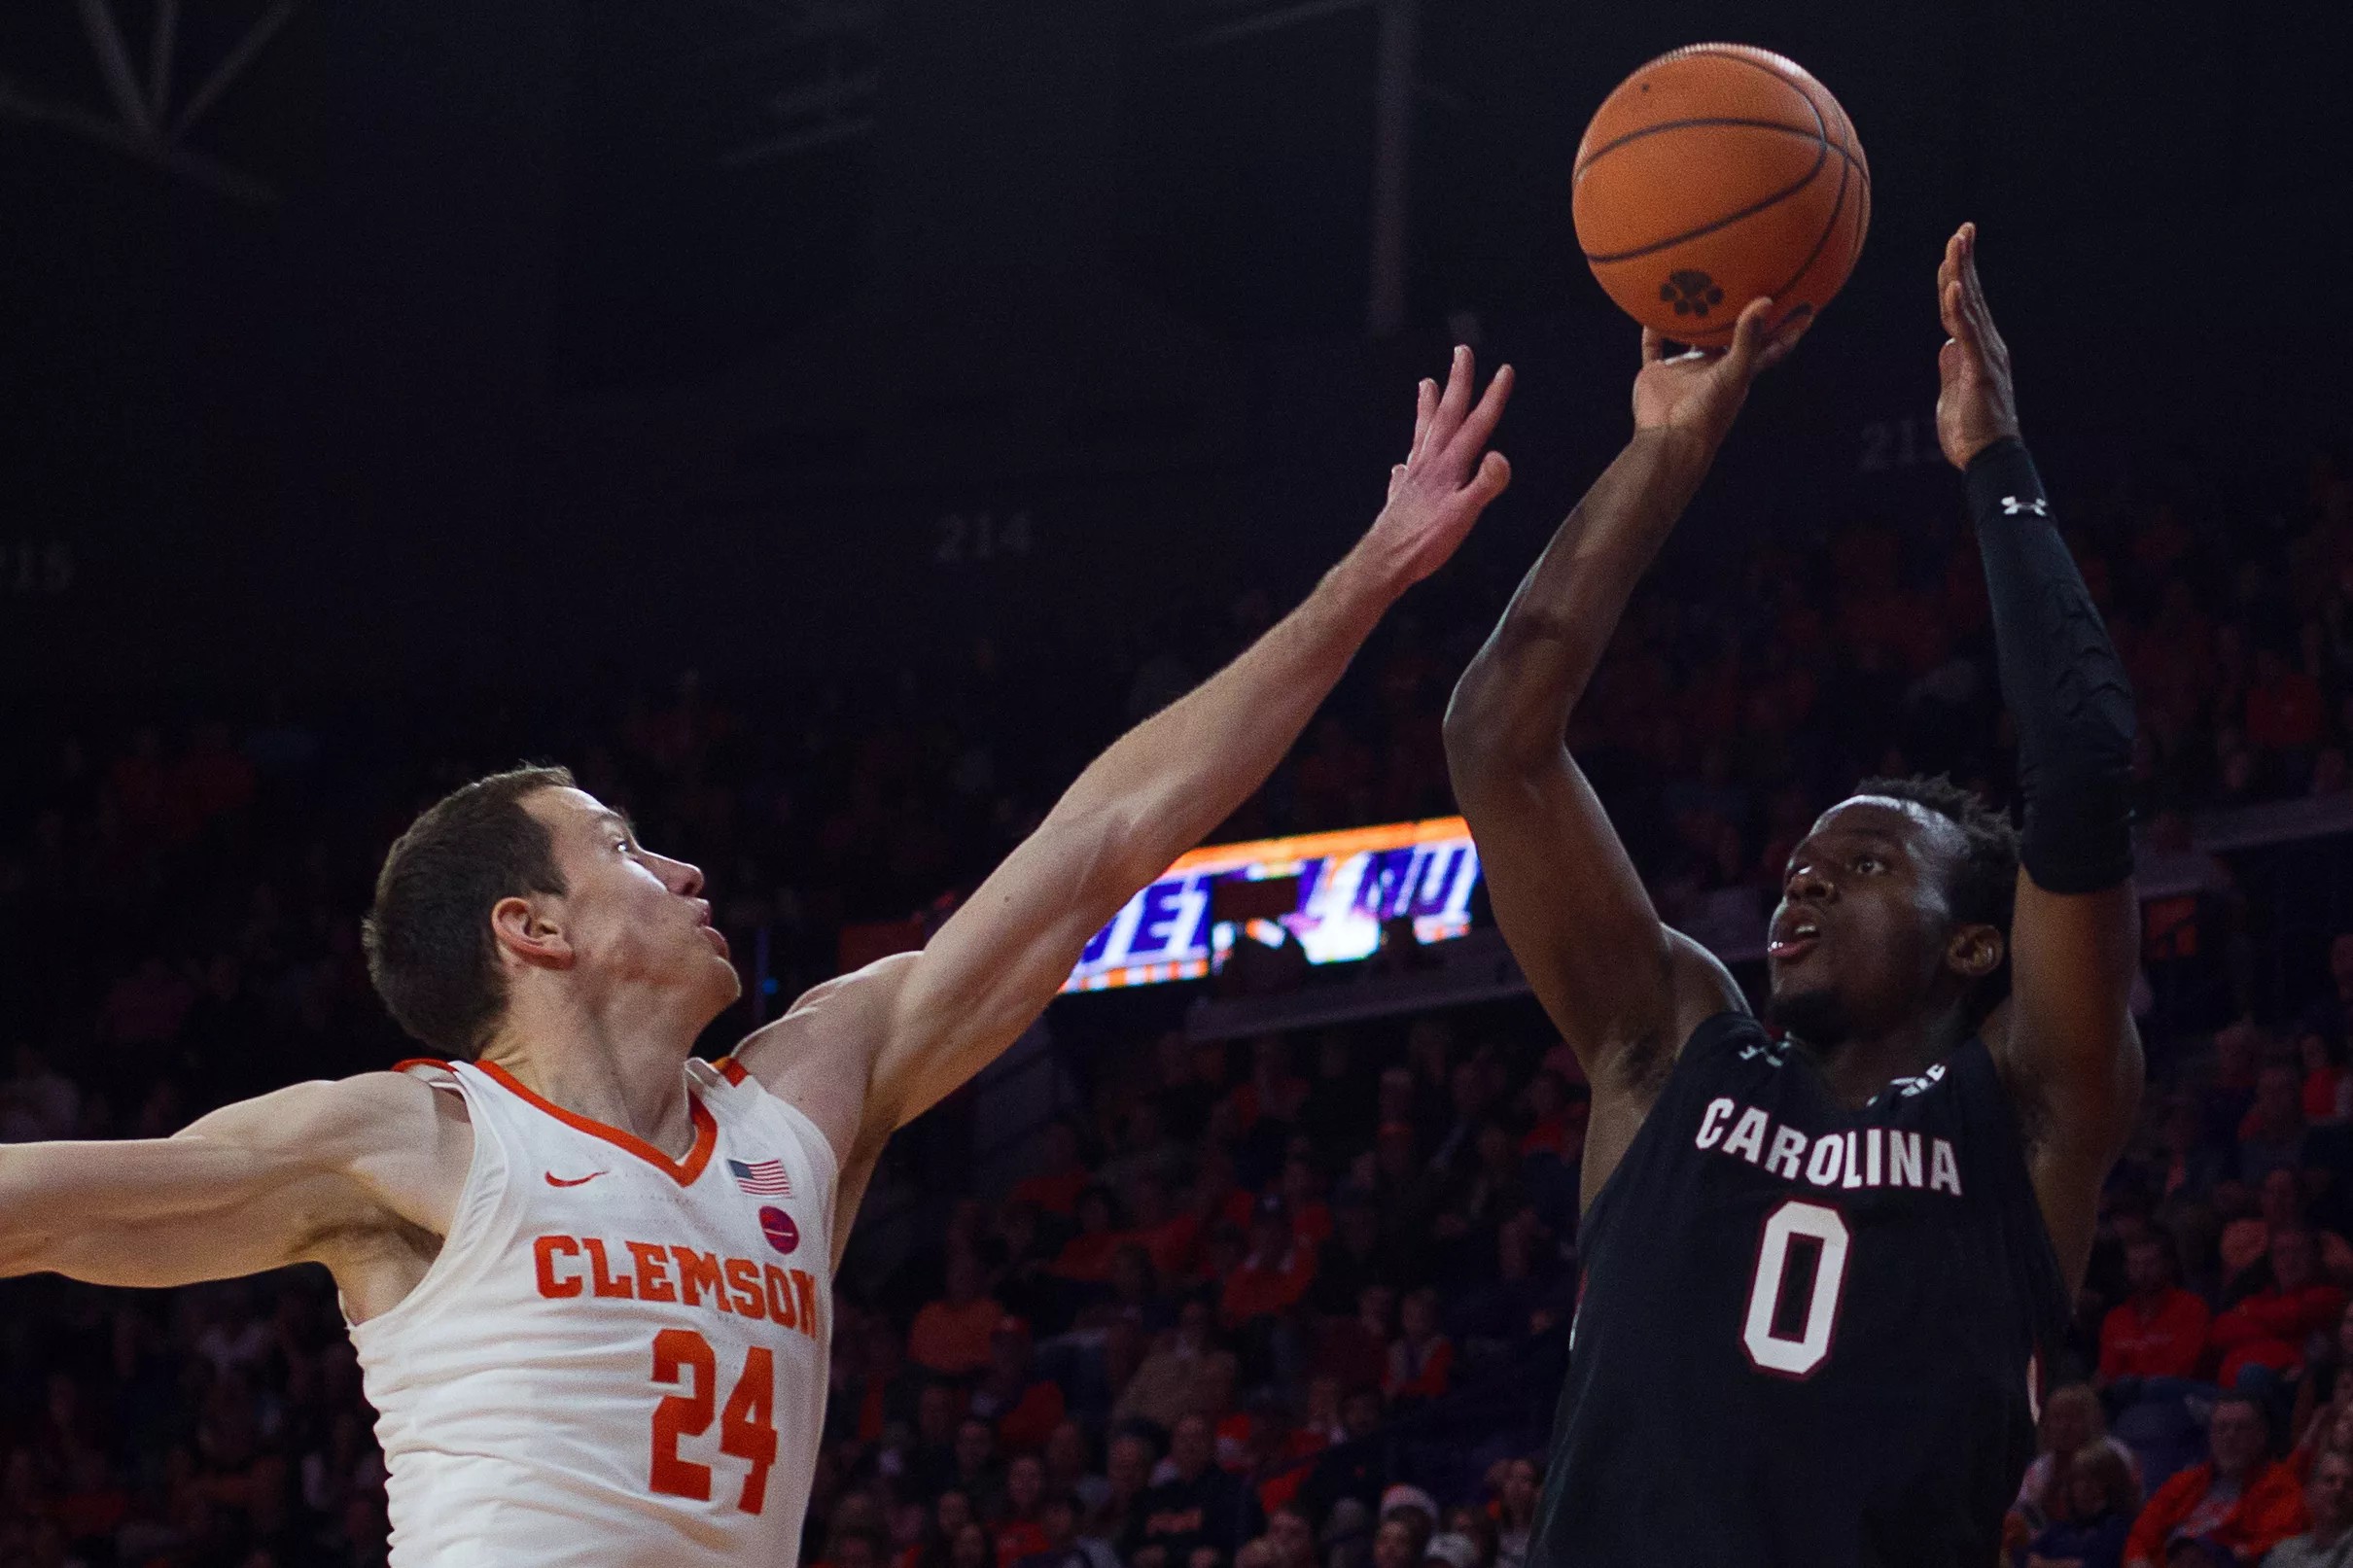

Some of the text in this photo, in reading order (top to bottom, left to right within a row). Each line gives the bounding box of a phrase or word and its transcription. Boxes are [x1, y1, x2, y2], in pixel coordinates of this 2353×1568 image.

[934, 510, 1033, 562] 214
[1695, 1098, 1963, 1197] CAROLINA
[533, 1235, 817, 1339] CLEMSON
[1740, 1196, 1850, 1376] 0
[649, 1329, 779, 1516] 24
